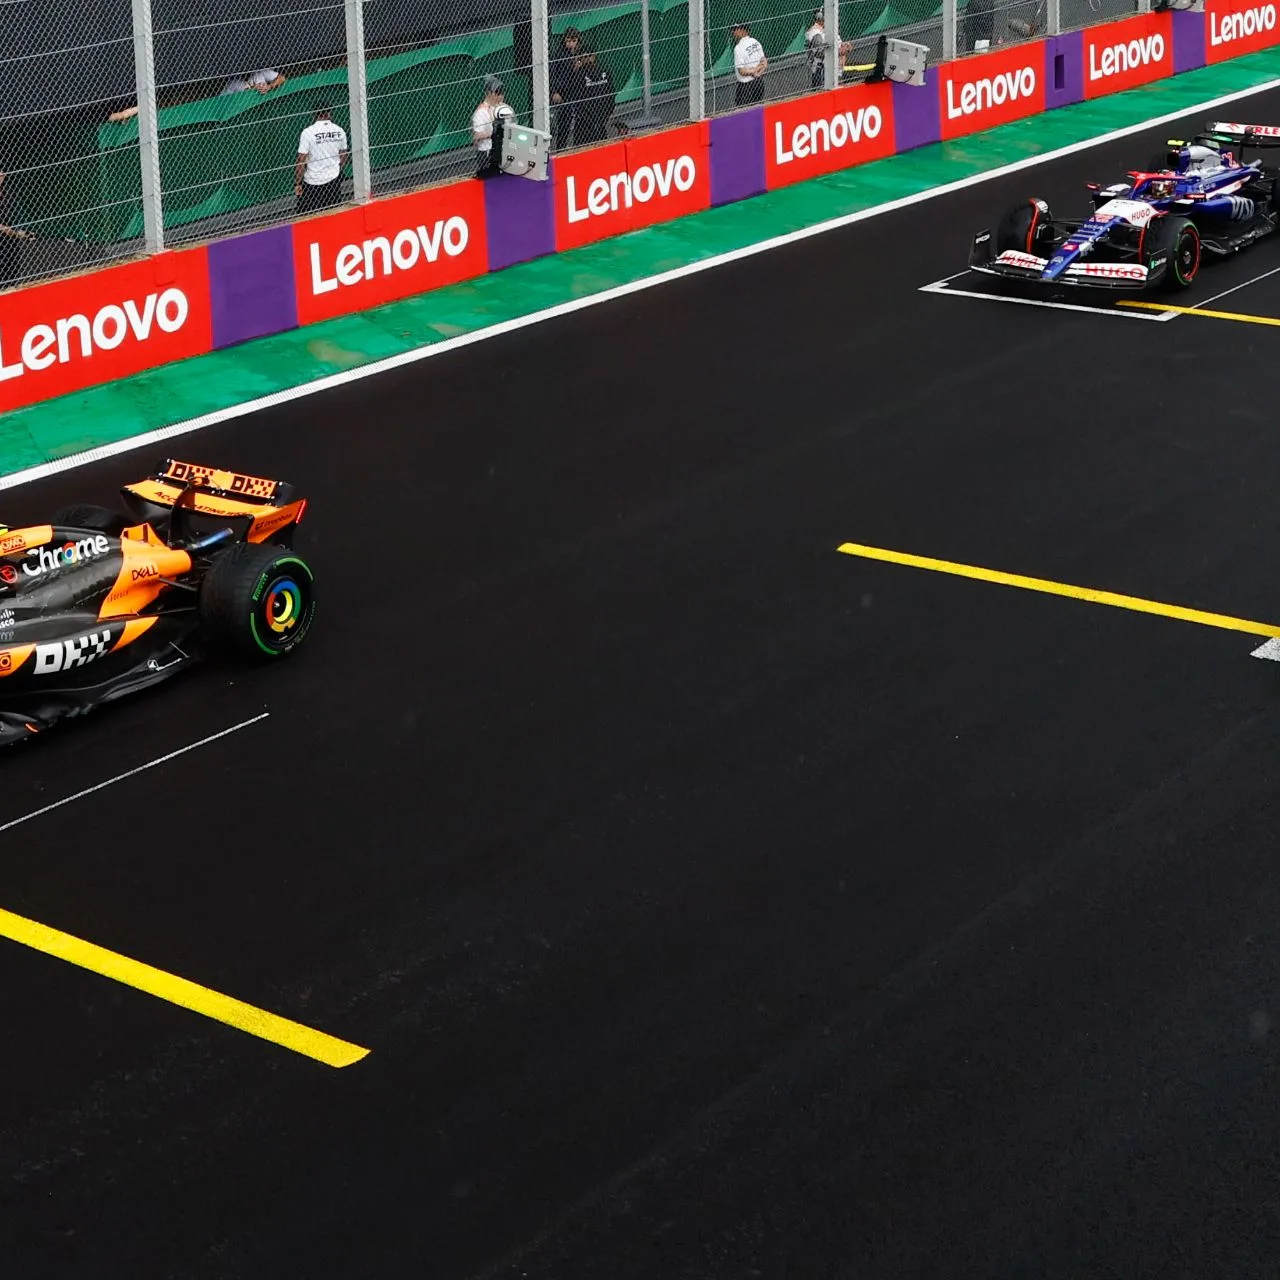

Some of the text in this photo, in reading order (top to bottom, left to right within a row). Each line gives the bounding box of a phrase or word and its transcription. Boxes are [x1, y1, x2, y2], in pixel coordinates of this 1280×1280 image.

[1211, 5, 1275, 45] Lenovo
[1090, 34, 1164, 80] Lenovo
[947, 67, 1035, 119] Lenovo
[315, 131, 342, 141] STAFF
[776, 106, 881, 164] Lenovo
[567, 156, 695, 222] Lenovo
[1131, 208, 1151, 221] HUGO
[310, 217, 468, 294] Lenovo
[1085, 263, 1145, 279] HUGO
[132, 566, 160, 580] DELL
